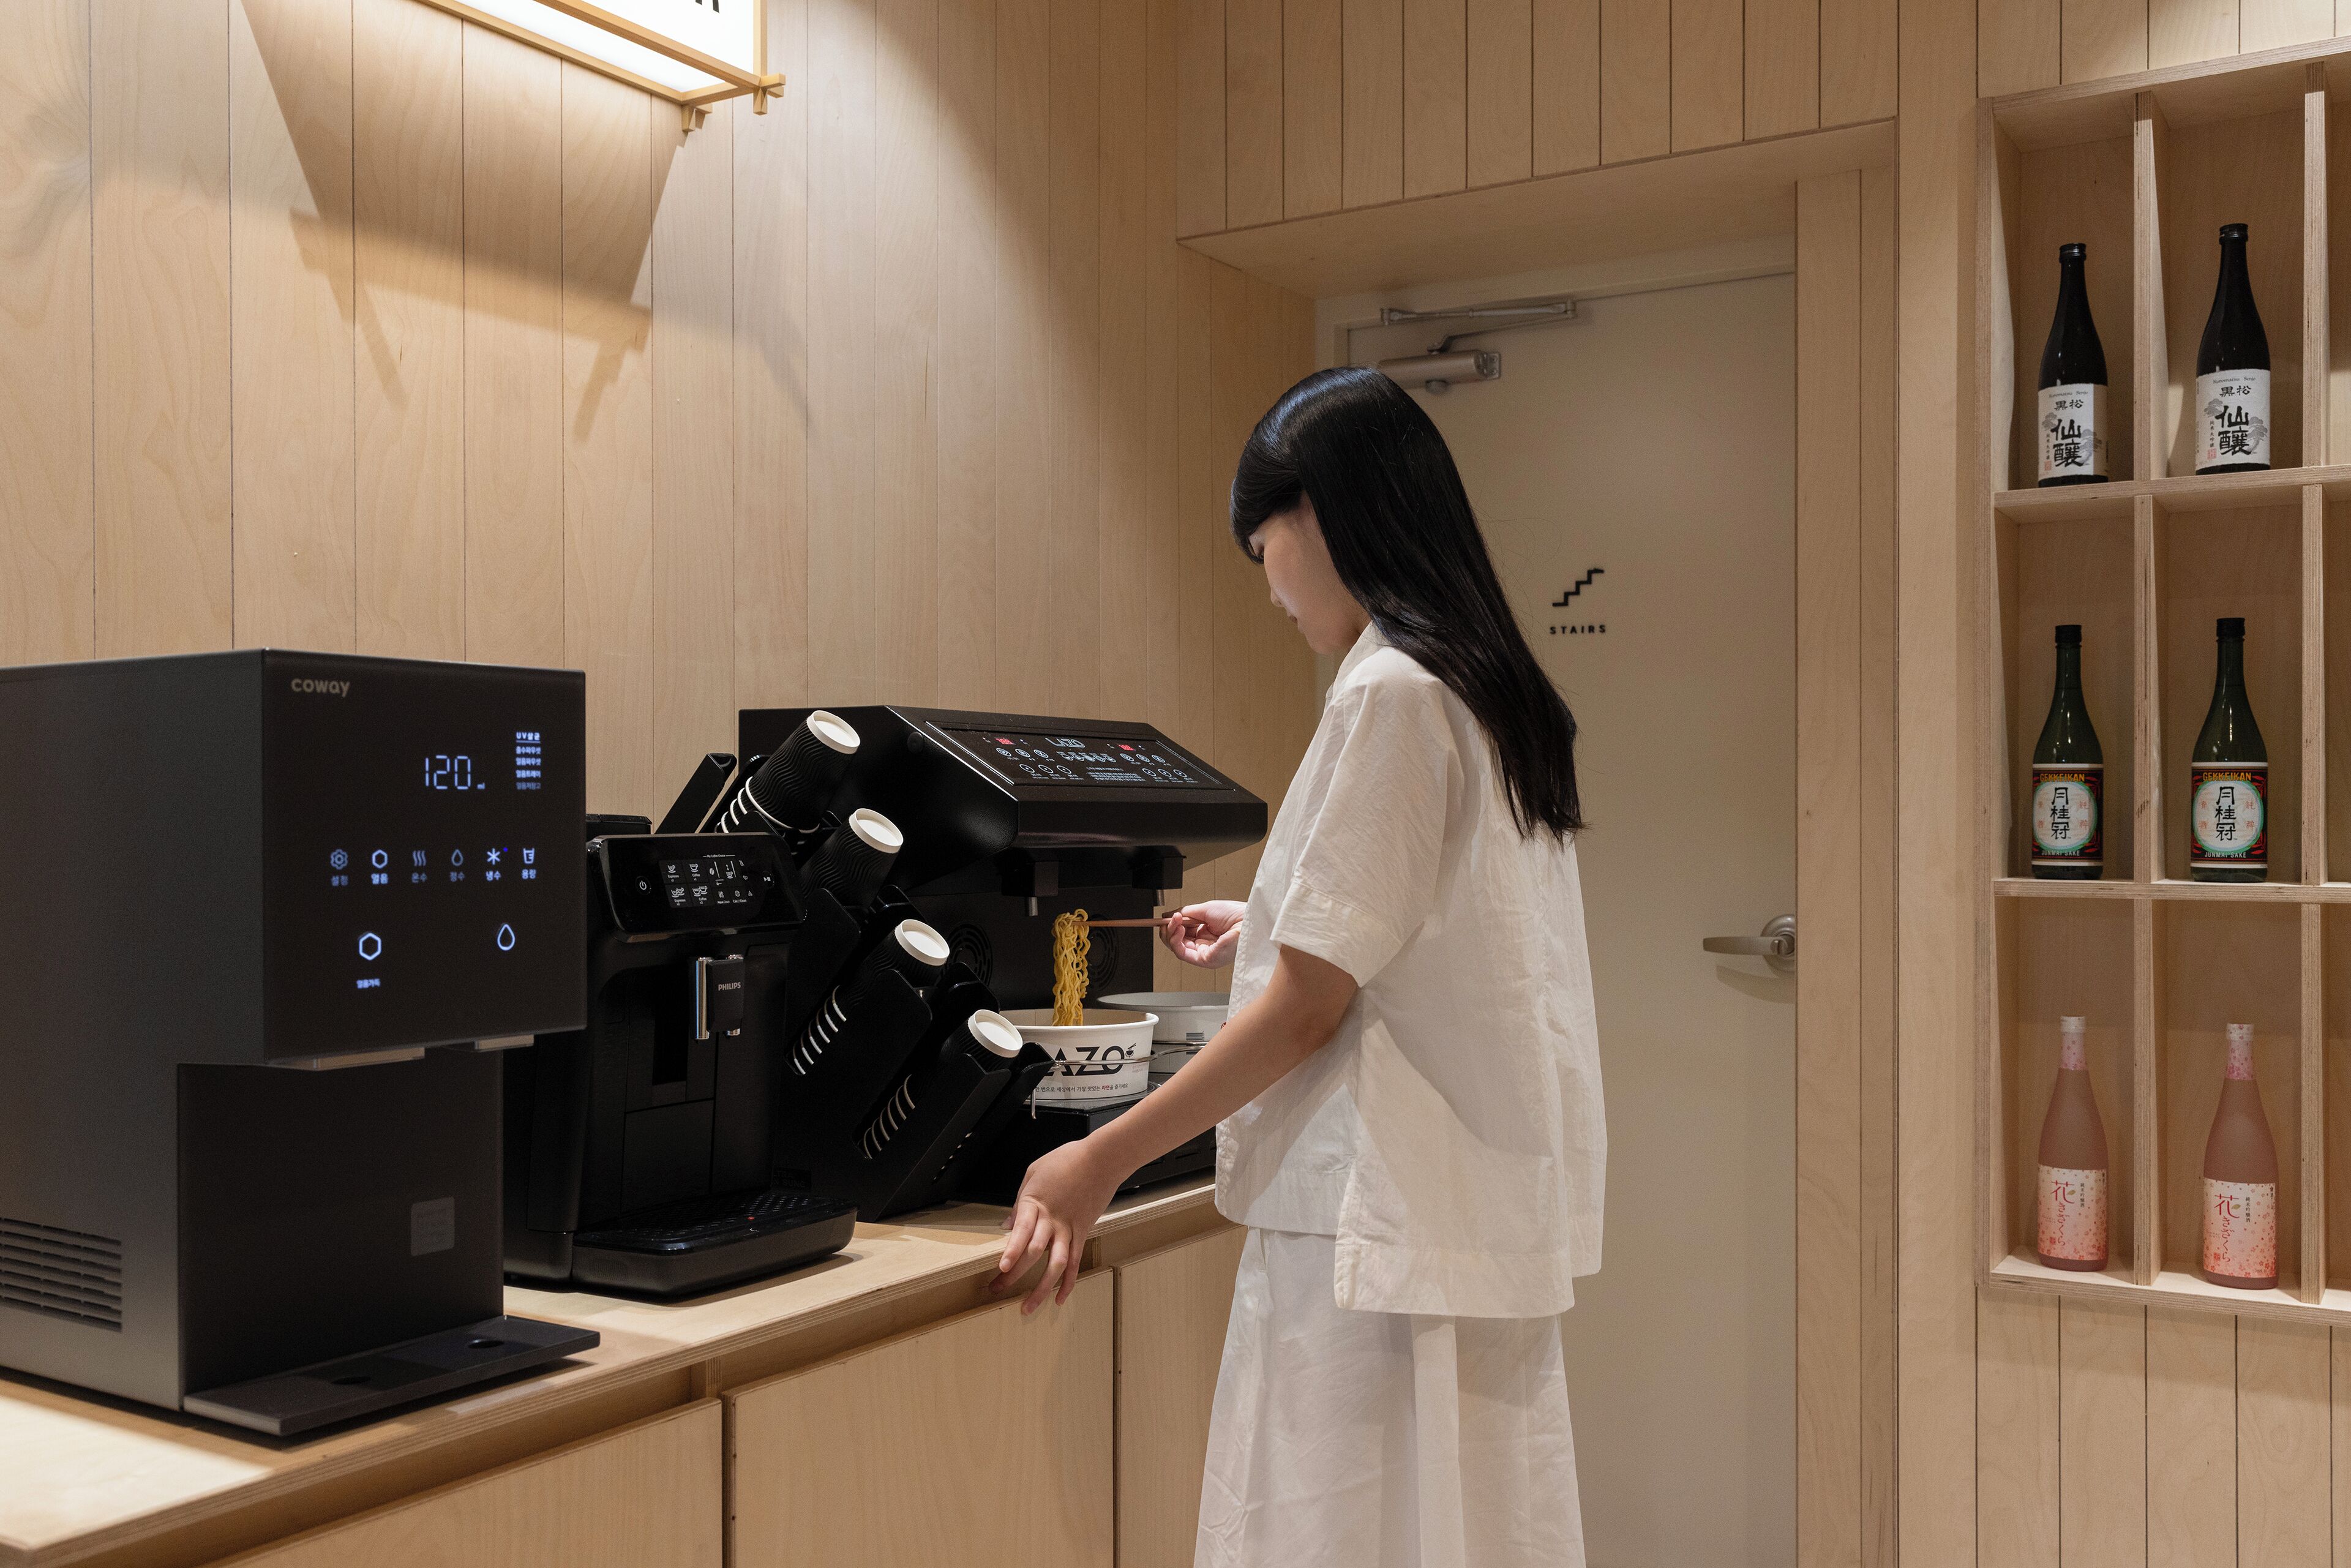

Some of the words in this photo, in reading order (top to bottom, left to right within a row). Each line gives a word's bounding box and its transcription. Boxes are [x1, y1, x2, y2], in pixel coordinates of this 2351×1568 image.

[1550, 625, 1606, 634] STAIRS
[291, 678, 350, 697] coway
[425, 755, 471, 790] 120
[2039, 773, 2085, 782] GEKKEIKAN
[2203, 772, 2252, 781] GEKKEIKAN
[2050, 787, 2071, 840] 月桂冠
[2214, 786, 2237, 841] 月桂冠
[718, 982, 741, 991] PHILIPS
[1043, 1046, 1125, 1076] AZO
